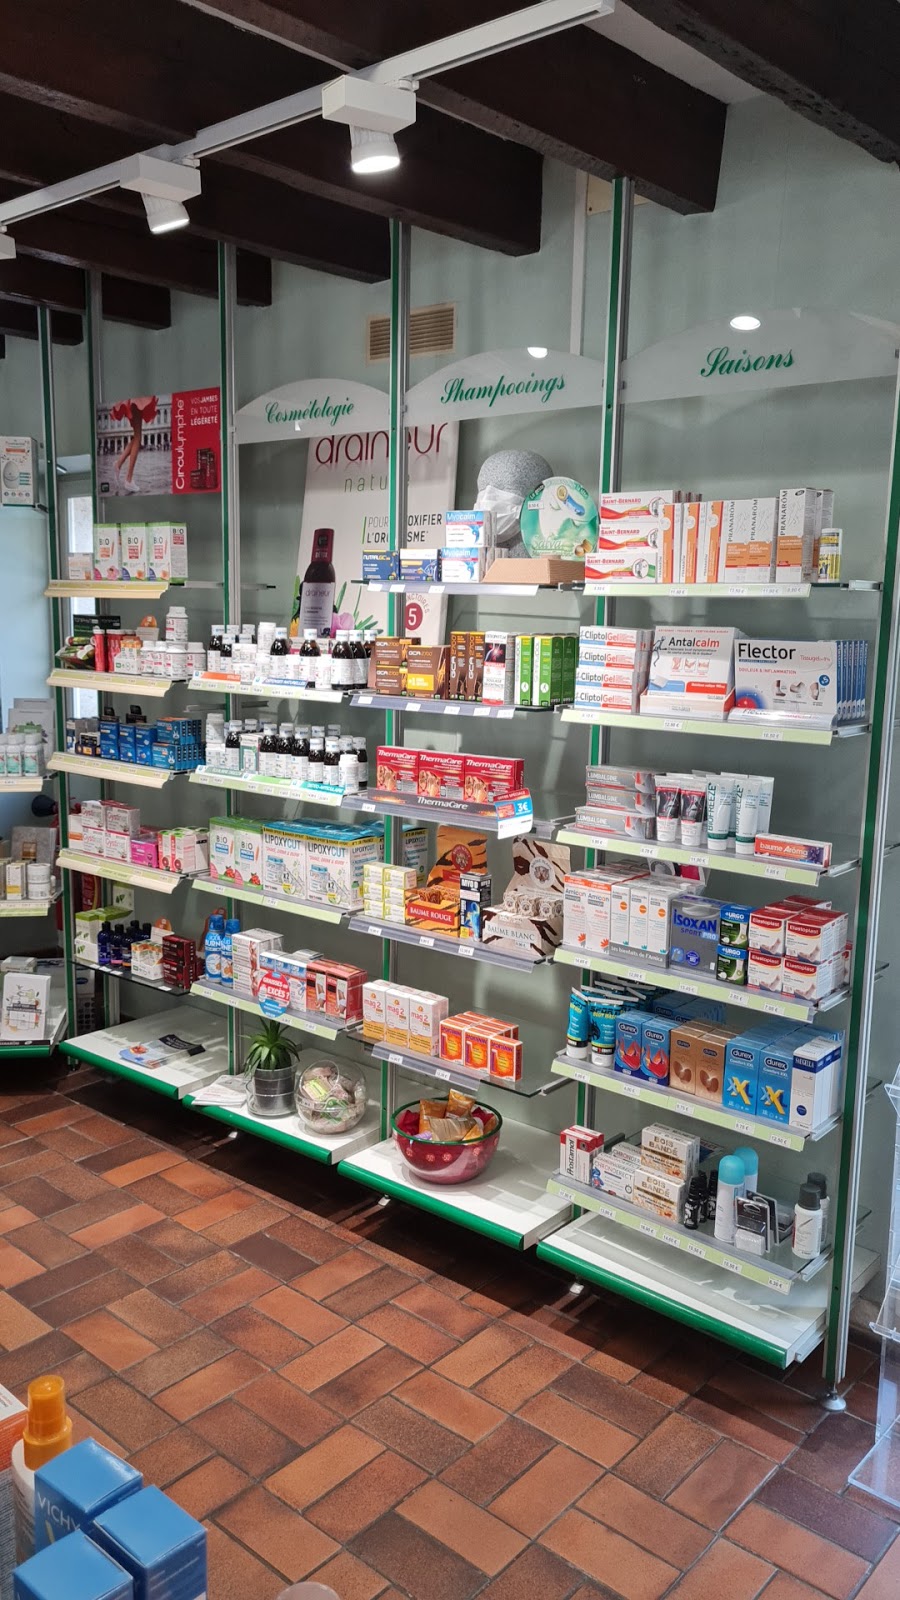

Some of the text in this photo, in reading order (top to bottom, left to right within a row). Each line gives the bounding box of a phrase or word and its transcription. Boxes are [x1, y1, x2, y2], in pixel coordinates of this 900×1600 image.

[700, 346, 795, 378] Saisons
[441, 372, 565, 407] Shampooings
[200, 394, 218, 403] JAMBES
[191, 405, 217, 415] EN TOUTE
[265, 395, 354, 426] Cosmétologie
[190, 414, 218, 426] LÉGÈRETÉ
[315, 422, 448, 464] drainur
[447, 511, 476, 523] Myocalm
[780, 490, 788, 536] PRANARÔM
[442, 548, 471, 559] Myocalm
[408, 609, 417, 627] 5
[584, 631, 619, 641] CliptolGel
[668, 637, 720, 648] Antalcalm
[584, 652, 618, 662] CliptolGel
[738, 643, 796, 660] Flector
[581, 672, 615, 683] CliptolGel
[579, 693, 614, 703] CliptolGel
[377, 749, 418, 760] ThermaCare
[419, 755, 463, 765] ThermaCare
[466, 759, 513, 770] ThermaCare
[417, 796, 469, 810] ThermaCare
[708, 783, 716, 831] BIOFREEZE
[264, 833, 301, 849] LIPOXYCUT
[307, 842, 346, 858] LIPOXYCUT
[759, 842, 783, 852] baume
[409, 907, 452, 923] BAUME ROUGE
[728, 912, 744, 920] URGO
[752, 917, 780, 928] Elastoplast
[487, 925, 535, 941] BAUME BLANC
[789, 924, 819, 935] Elastoplast
[725, 948, 741, 956] URGO
[752, 954, 779, 965] Elastoplast
[786, 961, 815, 973] Elastoplast
[363, 999, 376, 1009] mag
[387, 1005, 399, 1015] mag
[411, 1012, 423, 1022] mag
[619, 1024, 637, 1033] durex
[646, 1031, 664, 1041] durex
[732, 1050, 752, 1060] durex
[766, 1059, 786, 1069] durex
[649, 1141, 678, 1157] BANDÉ
[641, 1181, 671, 1198] BANDÉ
[37, 1492, 81, 1531] VICHY
